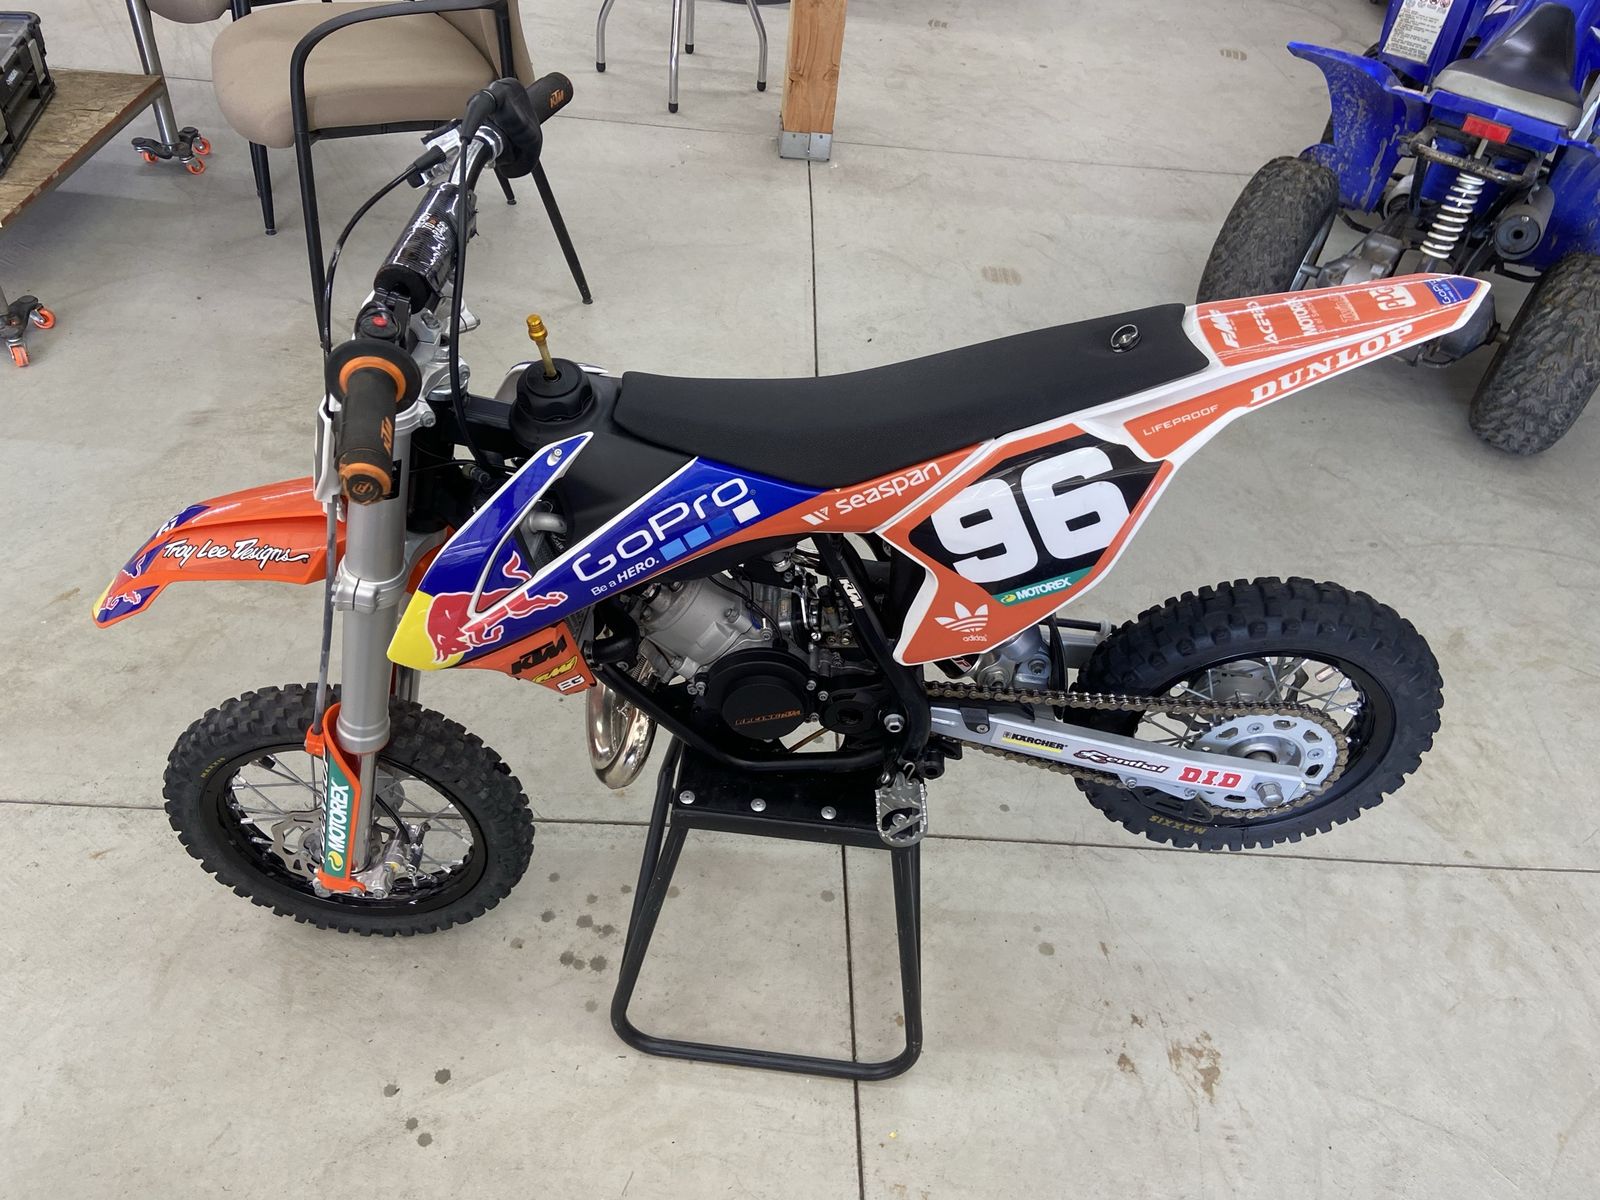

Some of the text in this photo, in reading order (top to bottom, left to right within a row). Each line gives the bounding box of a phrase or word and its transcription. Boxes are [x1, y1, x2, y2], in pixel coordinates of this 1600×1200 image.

[550, 89, 565, 109] KTM
[1250, 324, 1413, 404] DUNLOP
[1143, 403, 1219, 436] LIFEPROOF
[835, 462, 941, 515] seaspan
[572, 477, 749, 582] GoPro
[931, 446, 1130, 583] 96
[163, 538, 310, 570] Troy Lee Designs
[591, 556, 660, 596] Be a HERO.
[1015, 576, 1072, 601] MOTOREX
[838, 579, 864, 608] KTM
[962, 634, 988, 642] adidas
[511, 634, 567, 675] KTM
[1073, 749, 1170, 774] Renthal
[1178, 766, 1242, 788] D.I.D
[327, 777, 350, 853] MOTOREX
[1149, 815, 1207, 835] MAXXIS
